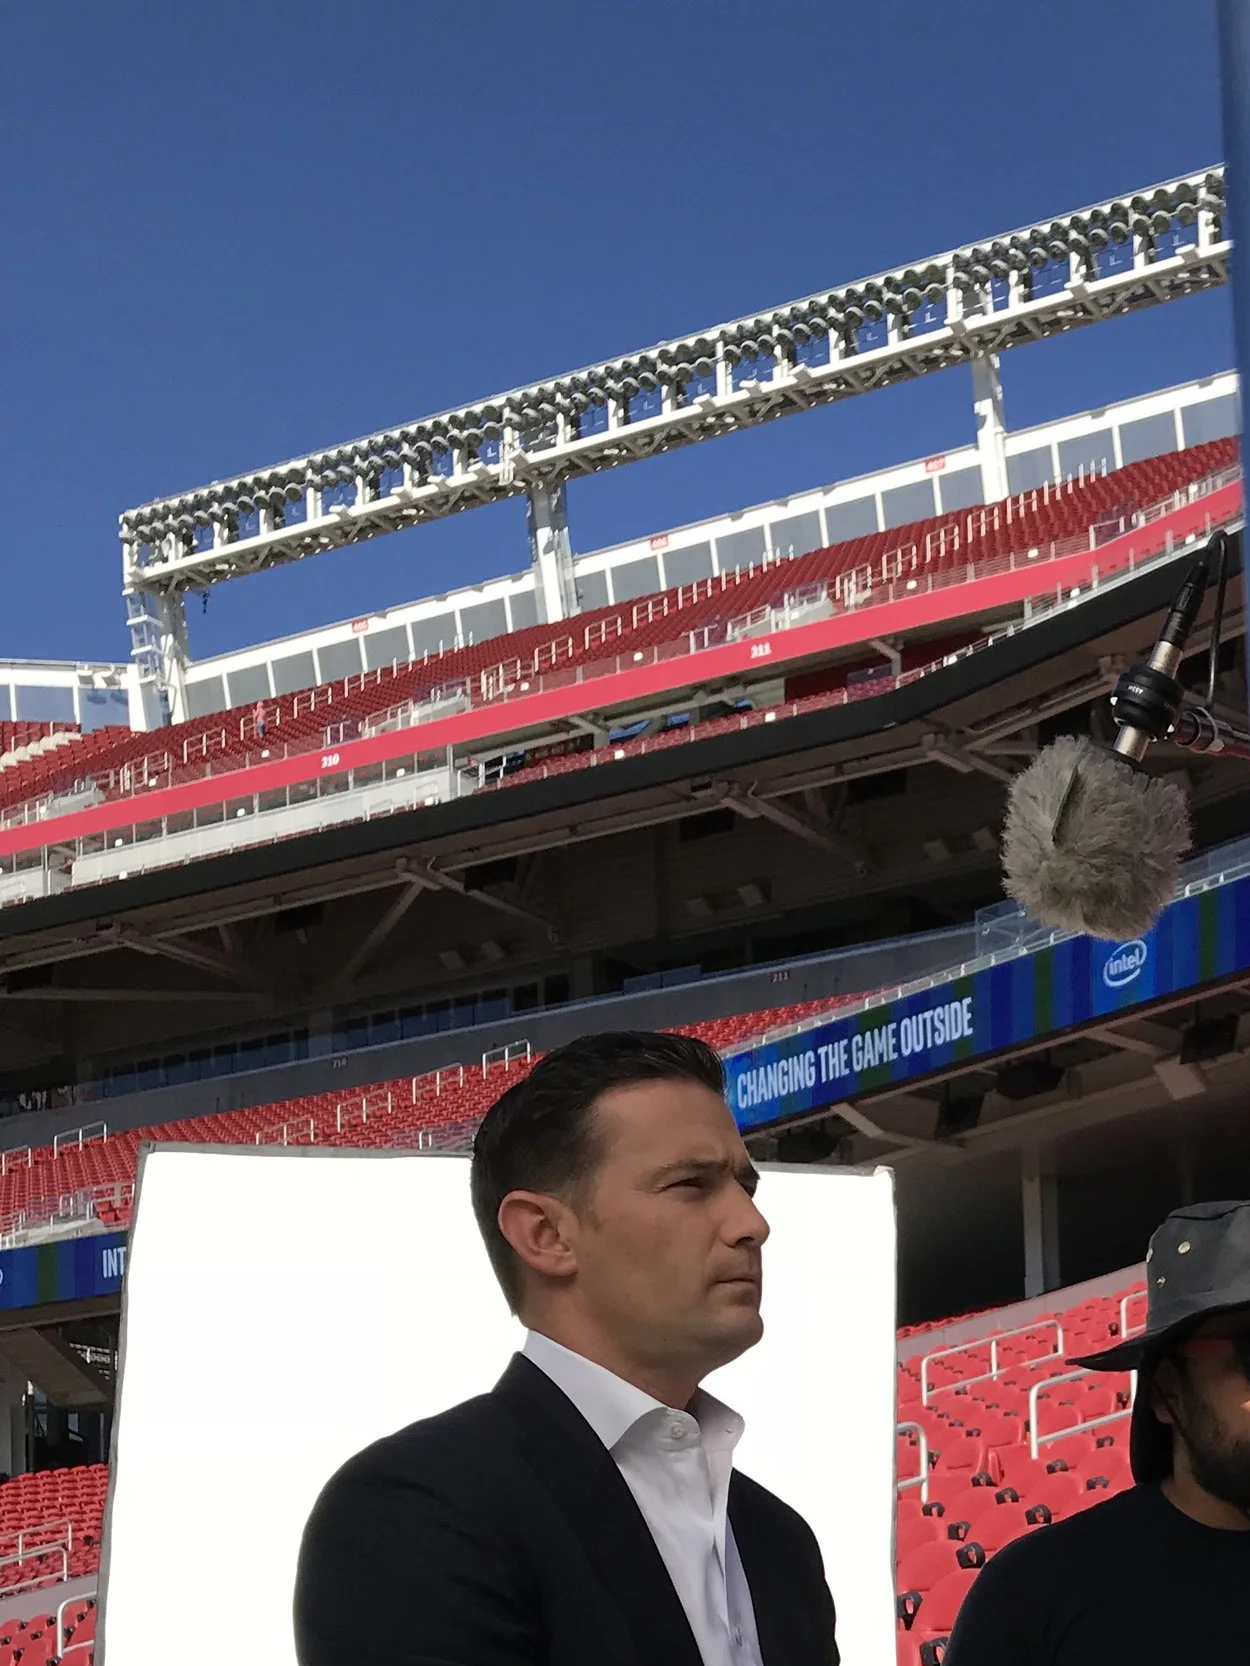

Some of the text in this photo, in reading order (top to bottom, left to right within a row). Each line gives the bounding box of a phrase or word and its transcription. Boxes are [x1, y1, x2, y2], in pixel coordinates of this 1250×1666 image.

[737, 997, 974, 1109] CHANGING THE GAME OUTSIDE
[103, 1246, 127, 1278] INT
